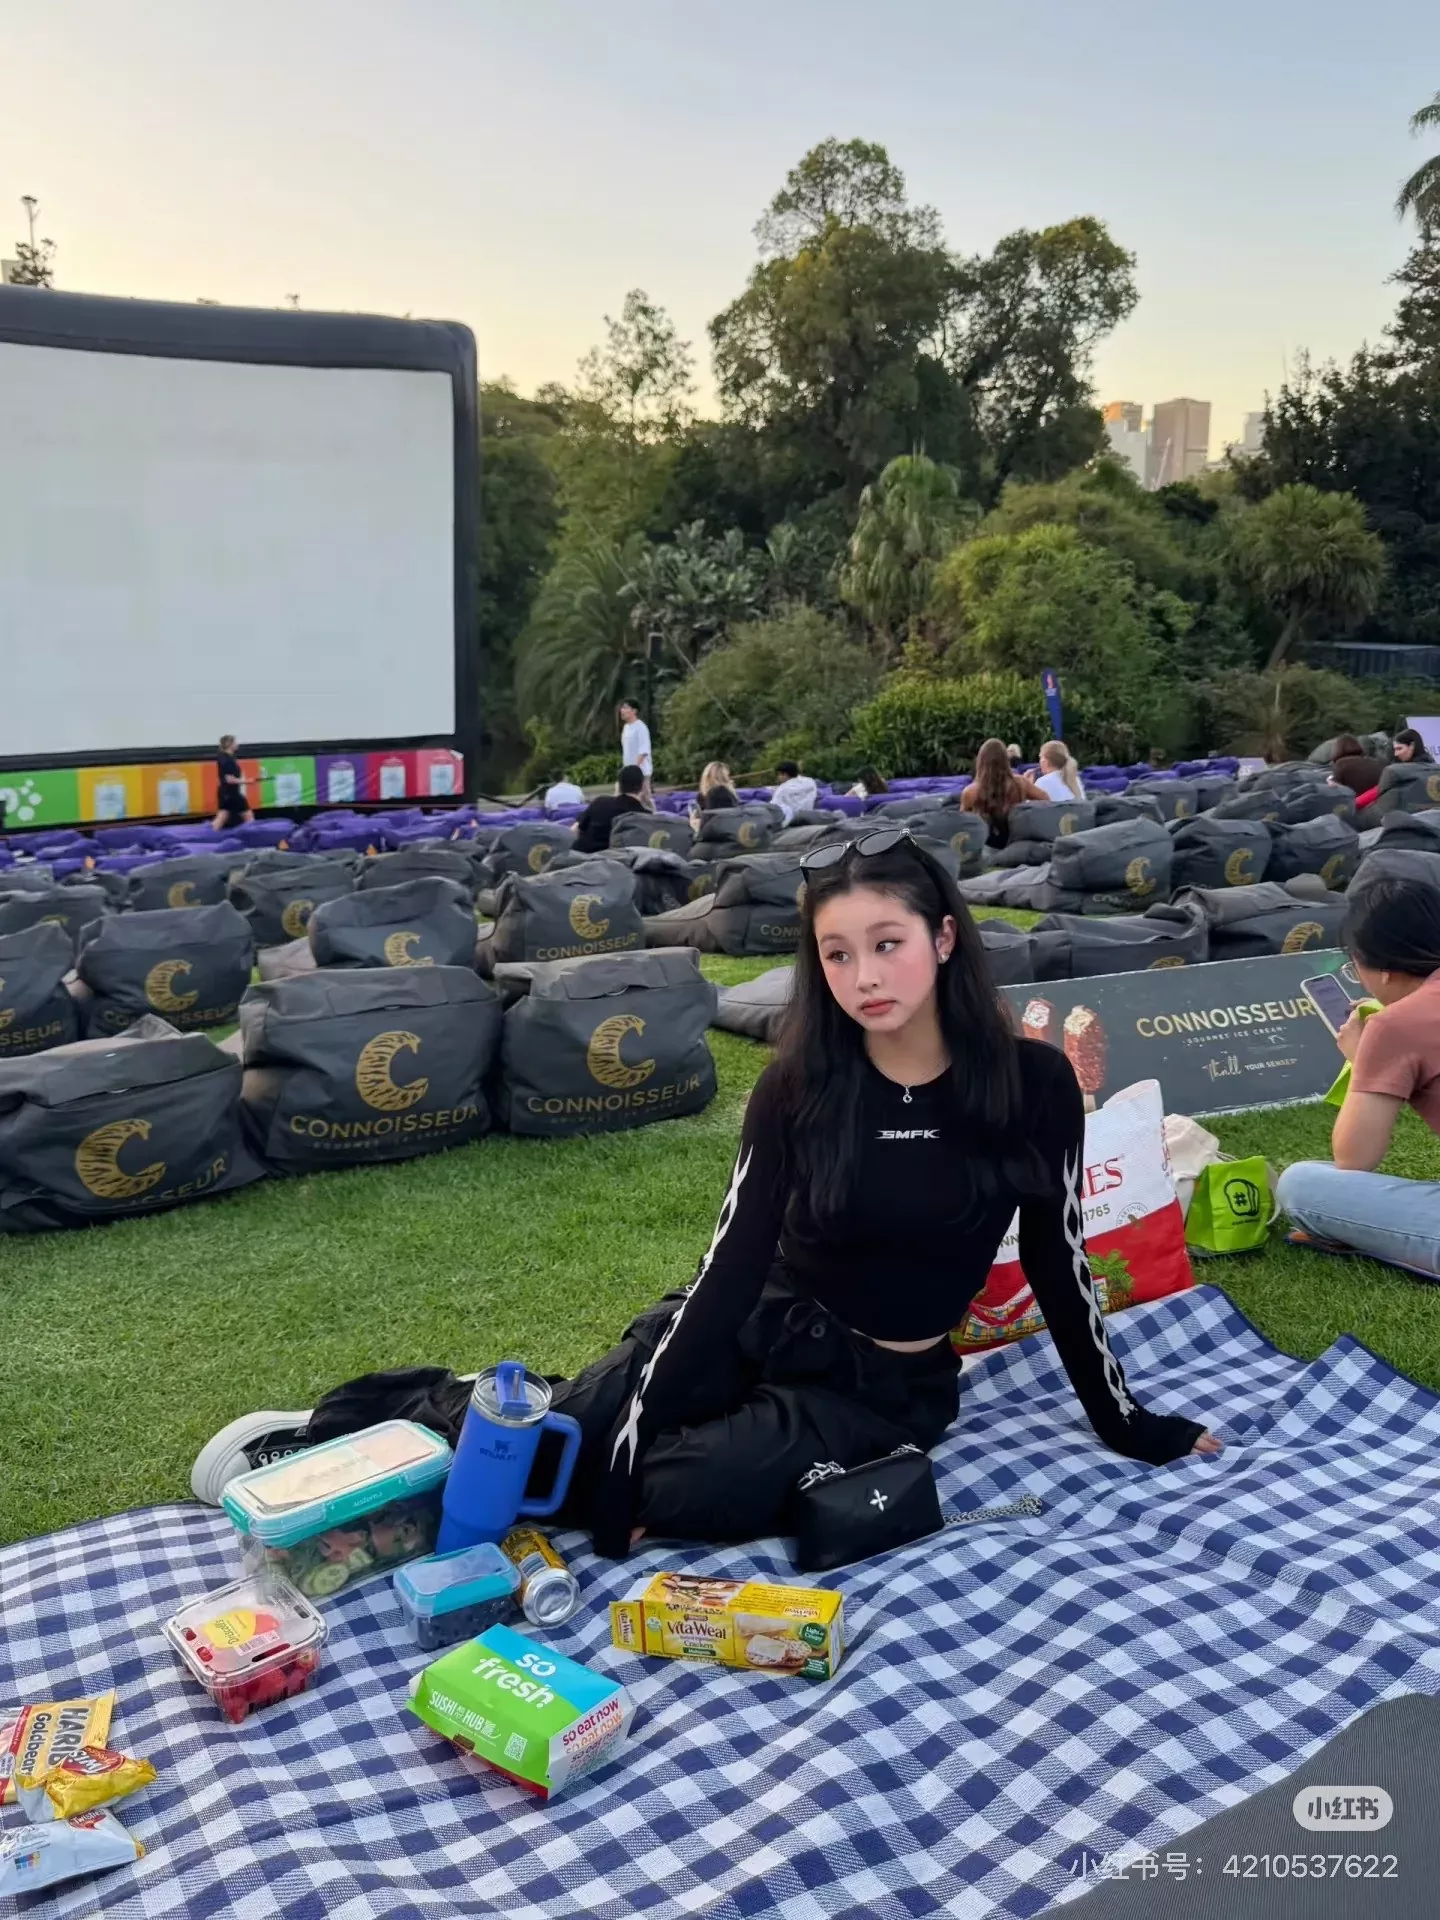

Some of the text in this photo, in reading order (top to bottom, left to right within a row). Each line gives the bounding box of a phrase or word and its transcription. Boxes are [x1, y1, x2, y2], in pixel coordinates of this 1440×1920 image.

[536, 932, 638, 959] CONNOISSEUR
[1136, 998, 1316, 1038] CONNOISSEUR
[1187, 1033, 1230, 1044] GOURMET
[1253, 1026, 1282, 1035] CREAM
[1244, 1062, 1265, 1071] YOUR
[528, 1074, 700, 1114] CONNOISSEUR
[290, 1104, 479, 1139] CONNOISSEUR
[876, 1129, 940, 1139] SMFK
[1083, 1203, 1111, 1221] 1765
[472, 1657, 555, 1708] fresh
[514, 1653, 556, 1677] so
[429, 1690, 458, 1716] SUSHI
[462, 1709, 485, 1731] HUB
[562, 1698, 619, 1746] so eat now
[20, 1712, 52, 1776] Goldbear
[50, 1707, 90, 1766] HARIB
[581, 1727, 599, 1746] eat
[600, 1712, 623, 1733] now
